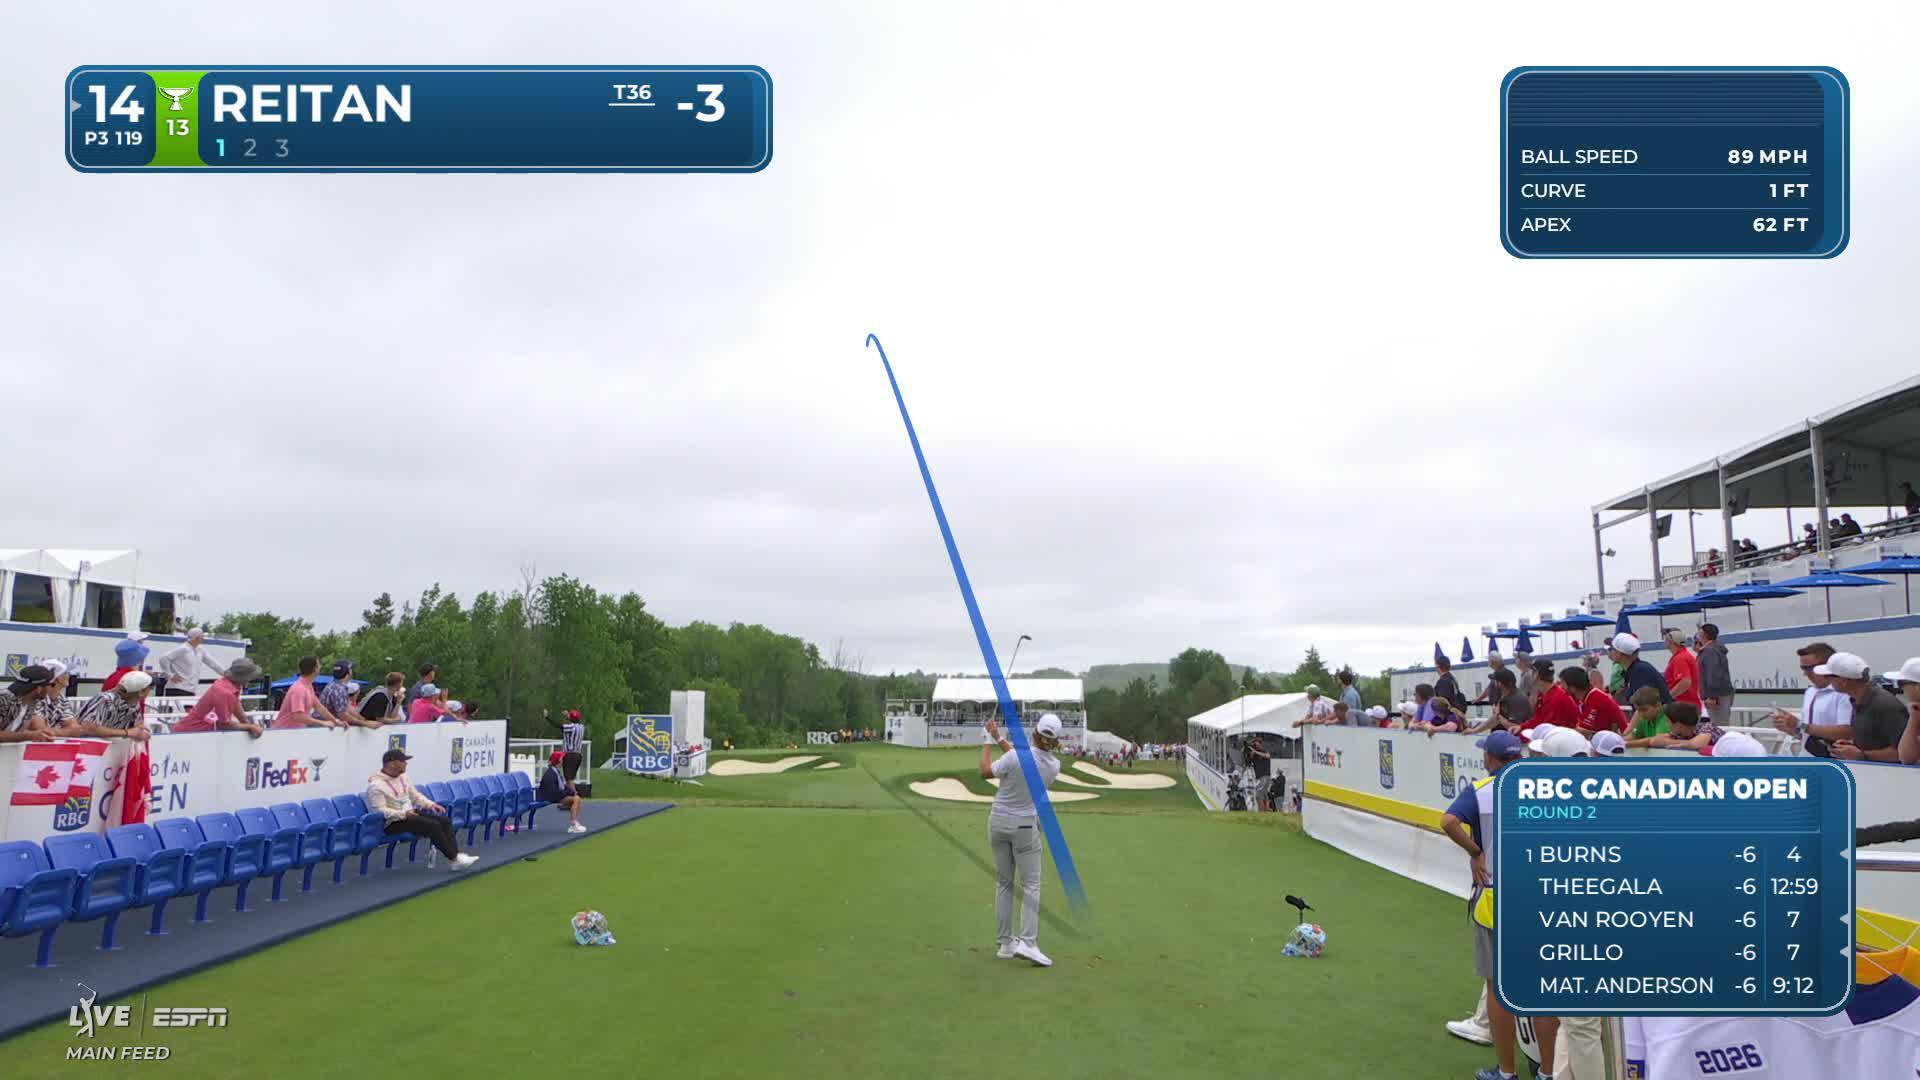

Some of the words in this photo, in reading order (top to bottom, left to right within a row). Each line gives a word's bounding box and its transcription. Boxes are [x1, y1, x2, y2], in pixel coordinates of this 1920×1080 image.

[464, 750, 496, 769] OPEN
[631, 755, 669, 769] RBC
[261, 759, 309, 789] FedEx
[56, 810, 88, 829] RBC
[1695, 1043, 1763, 1074] 2026
